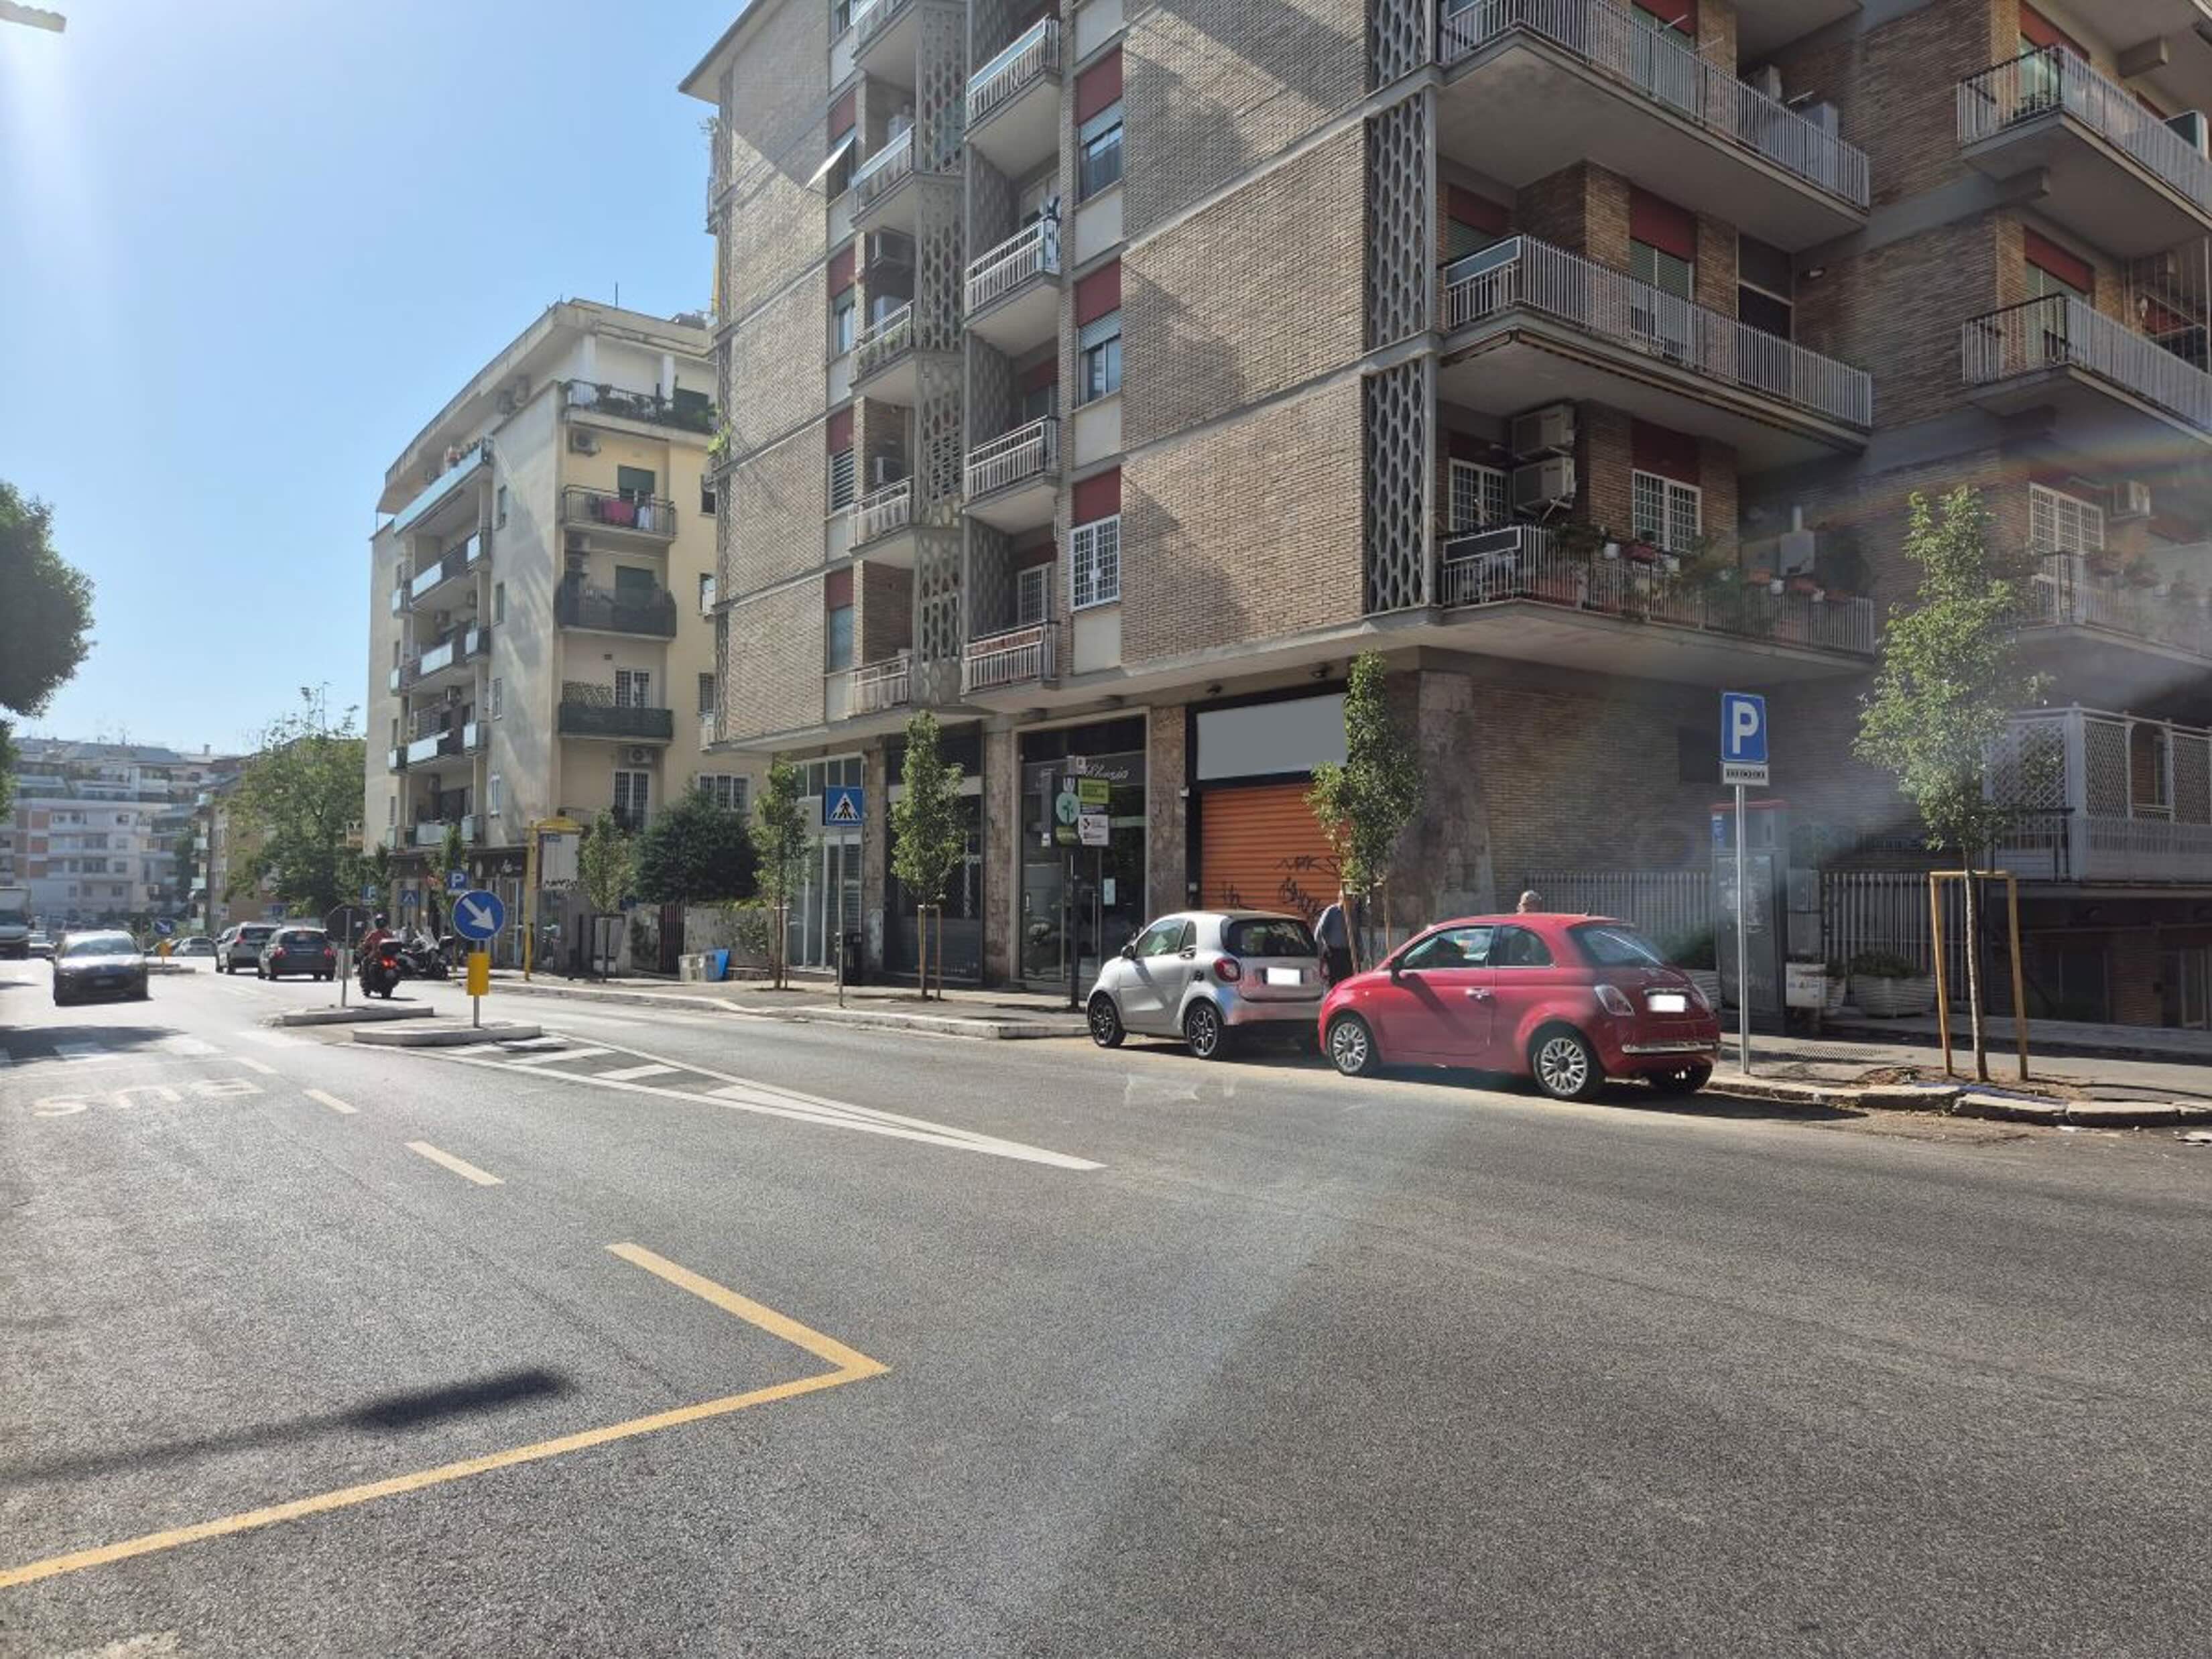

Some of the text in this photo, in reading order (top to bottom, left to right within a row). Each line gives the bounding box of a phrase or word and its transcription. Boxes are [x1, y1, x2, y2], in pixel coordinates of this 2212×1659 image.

[1732, 700, 1759, 754] P
[451, 873, 464, 888] P
[33, 1077, 265, 1117] BUS
